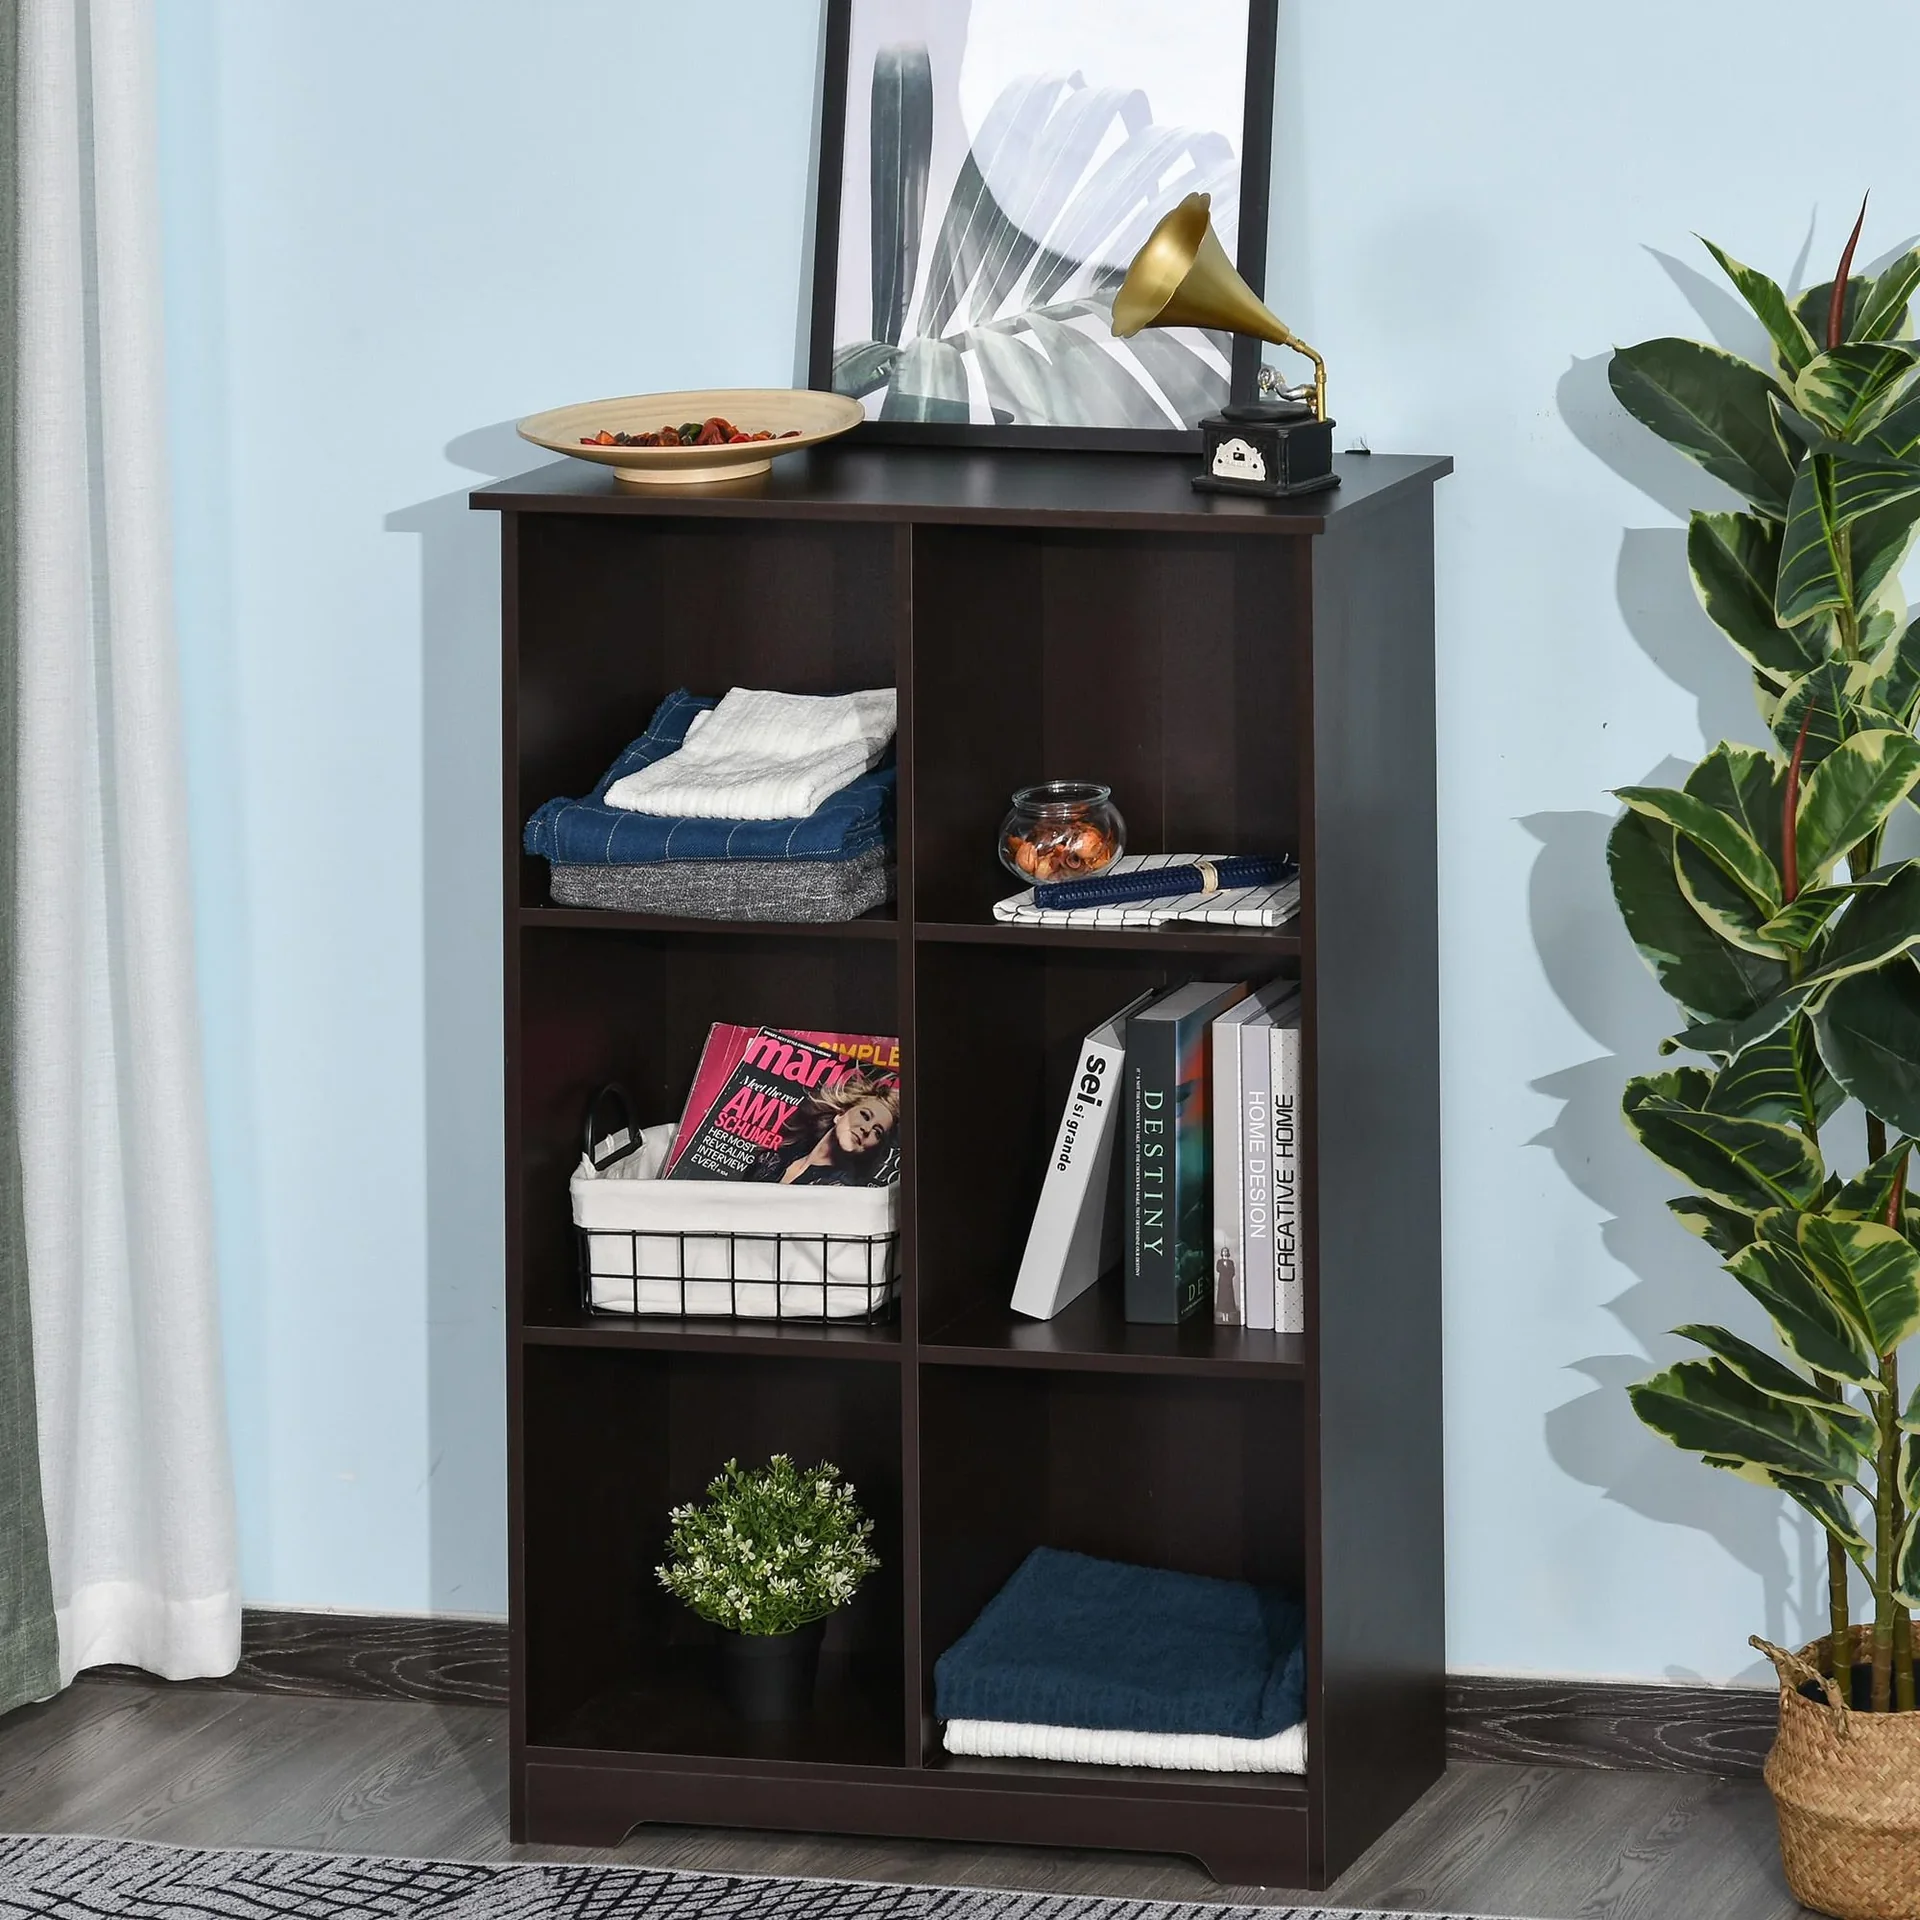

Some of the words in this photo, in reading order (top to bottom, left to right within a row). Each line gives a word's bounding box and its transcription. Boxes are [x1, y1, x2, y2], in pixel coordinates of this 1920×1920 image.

[739, 1075, 767, 1092] Meet
[765, 1084, 783, 1100] the
[780, 1094, 805, 1107] real
[1081, 1054, 1106, 1107] sei
[714, 1112, 784, 1151] SCHUMER
[721, 1086, 799, 1134] AMY
[1249, 1091, 1266, 1153] HOME
[1275, 1094, 1295, 1159] HOME
[690, 1153, 720, 1171] EVER!
[696, 1144, 748, 1172] INTERVIEW
[702, 1135, 756, 1164] REVEALING
[707, 1126, 729, 1141] HER
[726, 1135, 757, 1153] MOST
[1057, 1119, 1079, 1172] grande
[1143, 1091, 1164, 1257] DESTINY
[1275, 1169, 1296, 1282] CREATIVE
